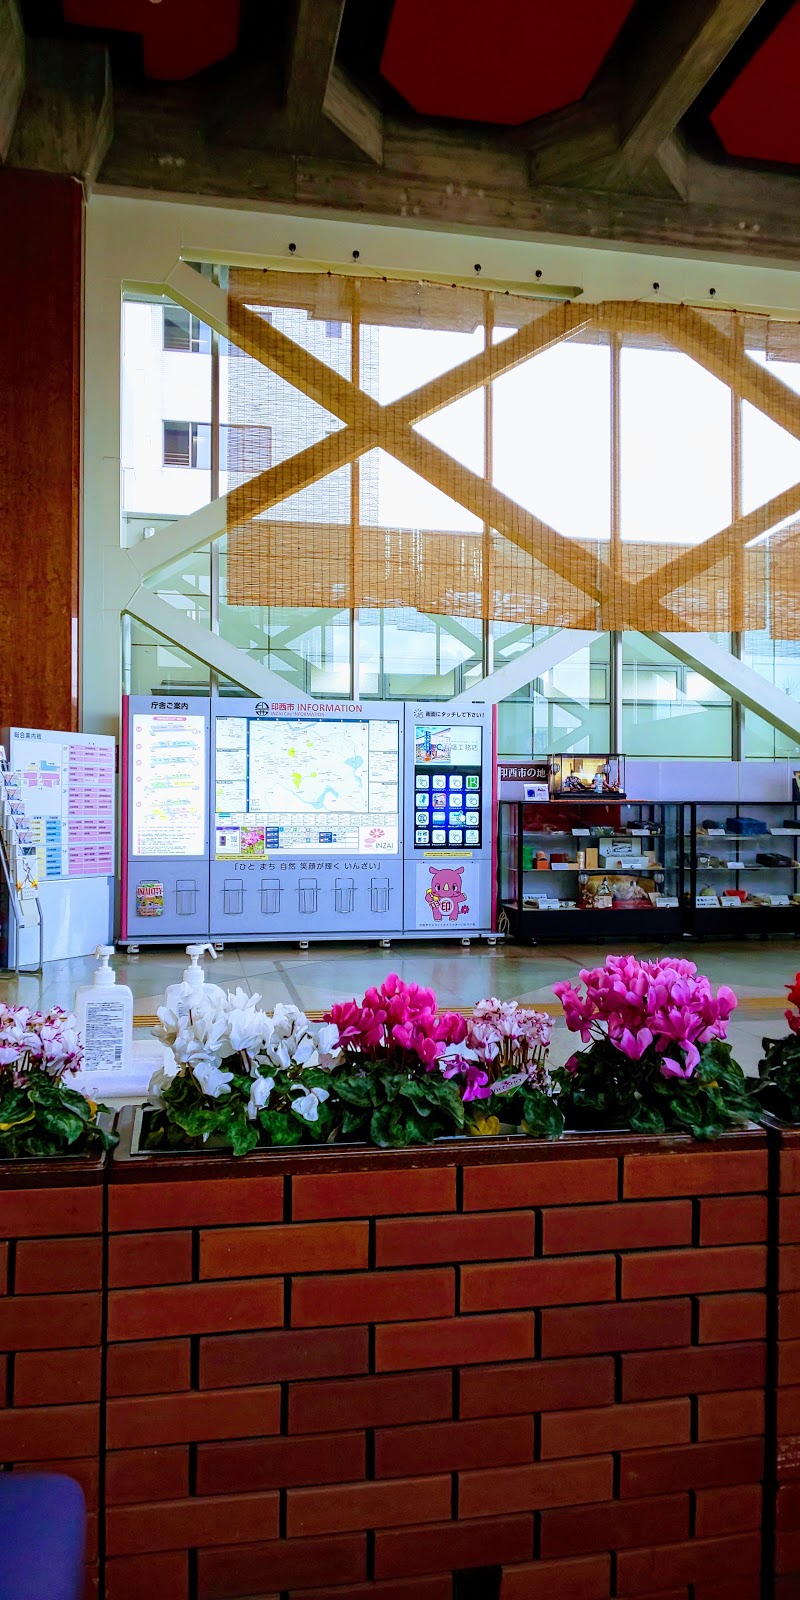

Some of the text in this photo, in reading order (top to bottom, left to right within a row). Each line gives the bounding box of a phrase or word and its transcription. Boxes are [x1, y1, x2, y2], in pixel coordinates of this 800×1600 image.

[151, 701, 189, 710] 庁舎ご案内
[271, 703, 362, 712] 印西市 INFORMATION
[259, 862, 276, 871] まち
[280, 862, 296, 870] 自然
